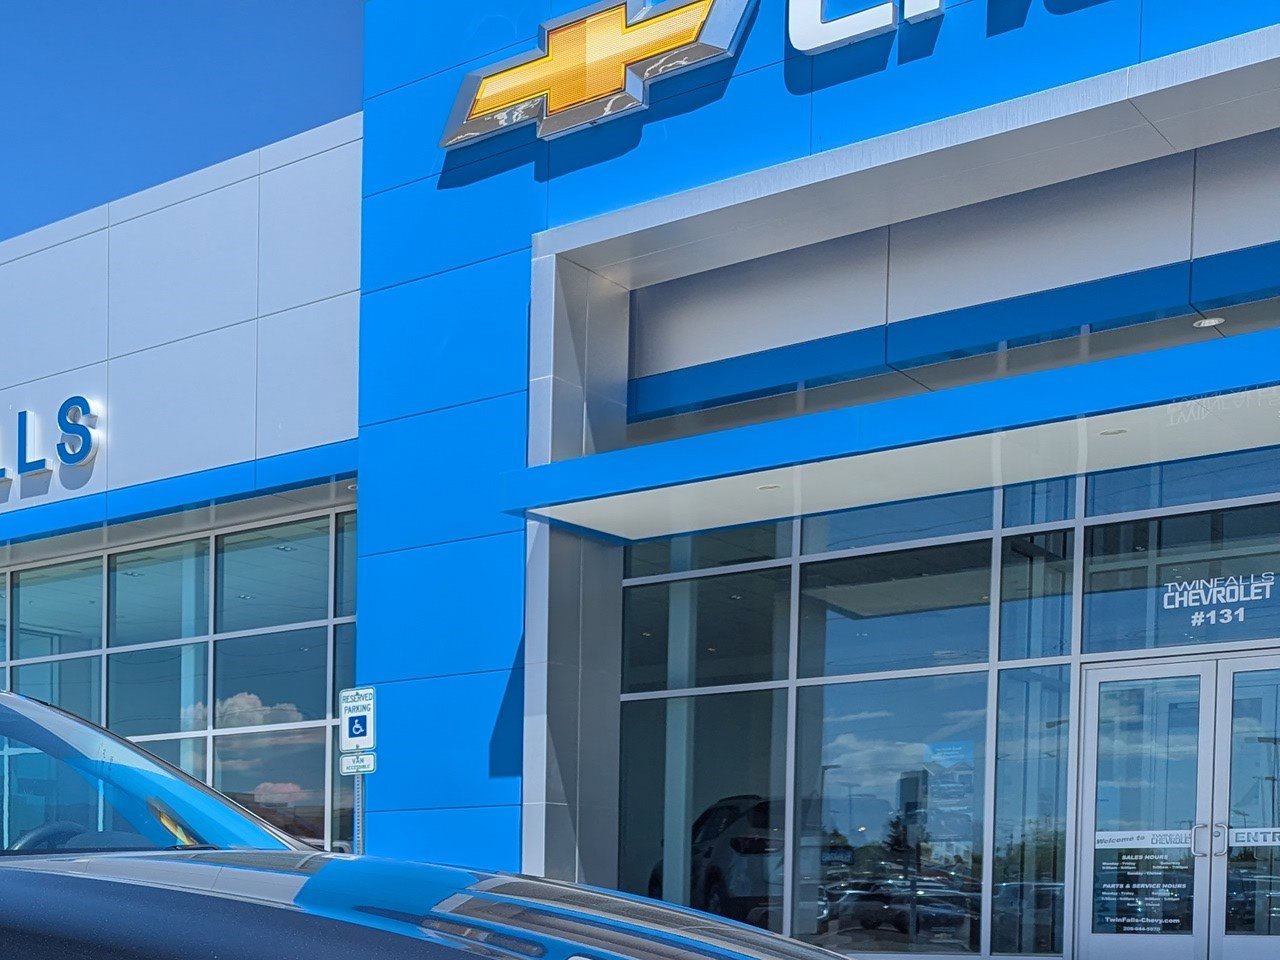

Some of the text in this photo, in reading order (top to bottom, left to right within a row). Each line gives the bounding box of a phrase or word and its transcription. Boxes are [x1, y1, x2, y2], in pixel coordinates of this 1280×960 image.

[1163, 582, 1275, 609] CHEVROLET
[1191, 607, 1245, 627] #131
[342, 693, 373, 704] RESERVED
[344, 704, 371, 714] PARKING
[1096, 836, 1134, 845] Welcome
